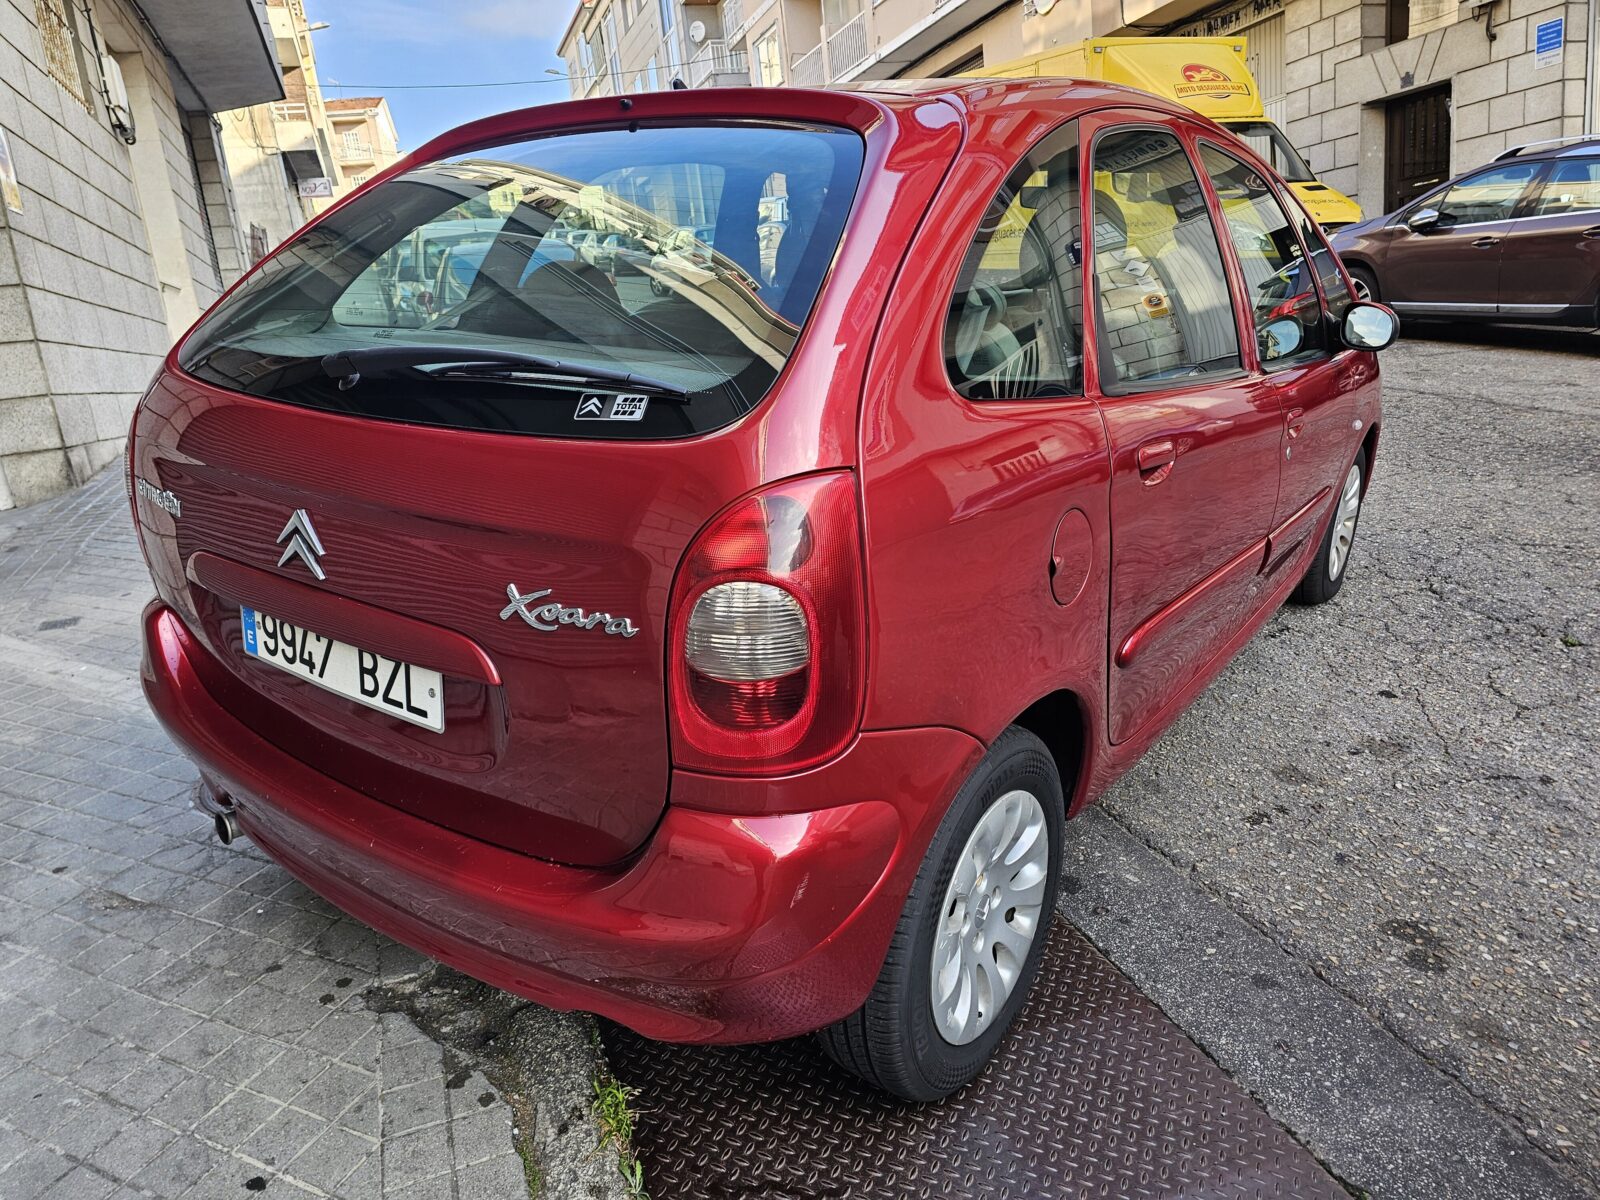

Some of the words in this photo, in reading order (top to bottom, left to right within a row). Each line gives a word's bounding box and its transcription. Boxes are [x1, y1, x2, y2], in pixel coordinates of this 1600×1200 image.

[1177, 85, 1197, 94] MOTO
[1196, 84, 1231, 92] DESGUACES
[1231, 84, 1246, 92] ALPE
[499, 583, 640, 638] Xsara
[247, 629, 255, 645] E
[262, 613, 334, 679] 9947
[358, 648, 429, 719] BZL
